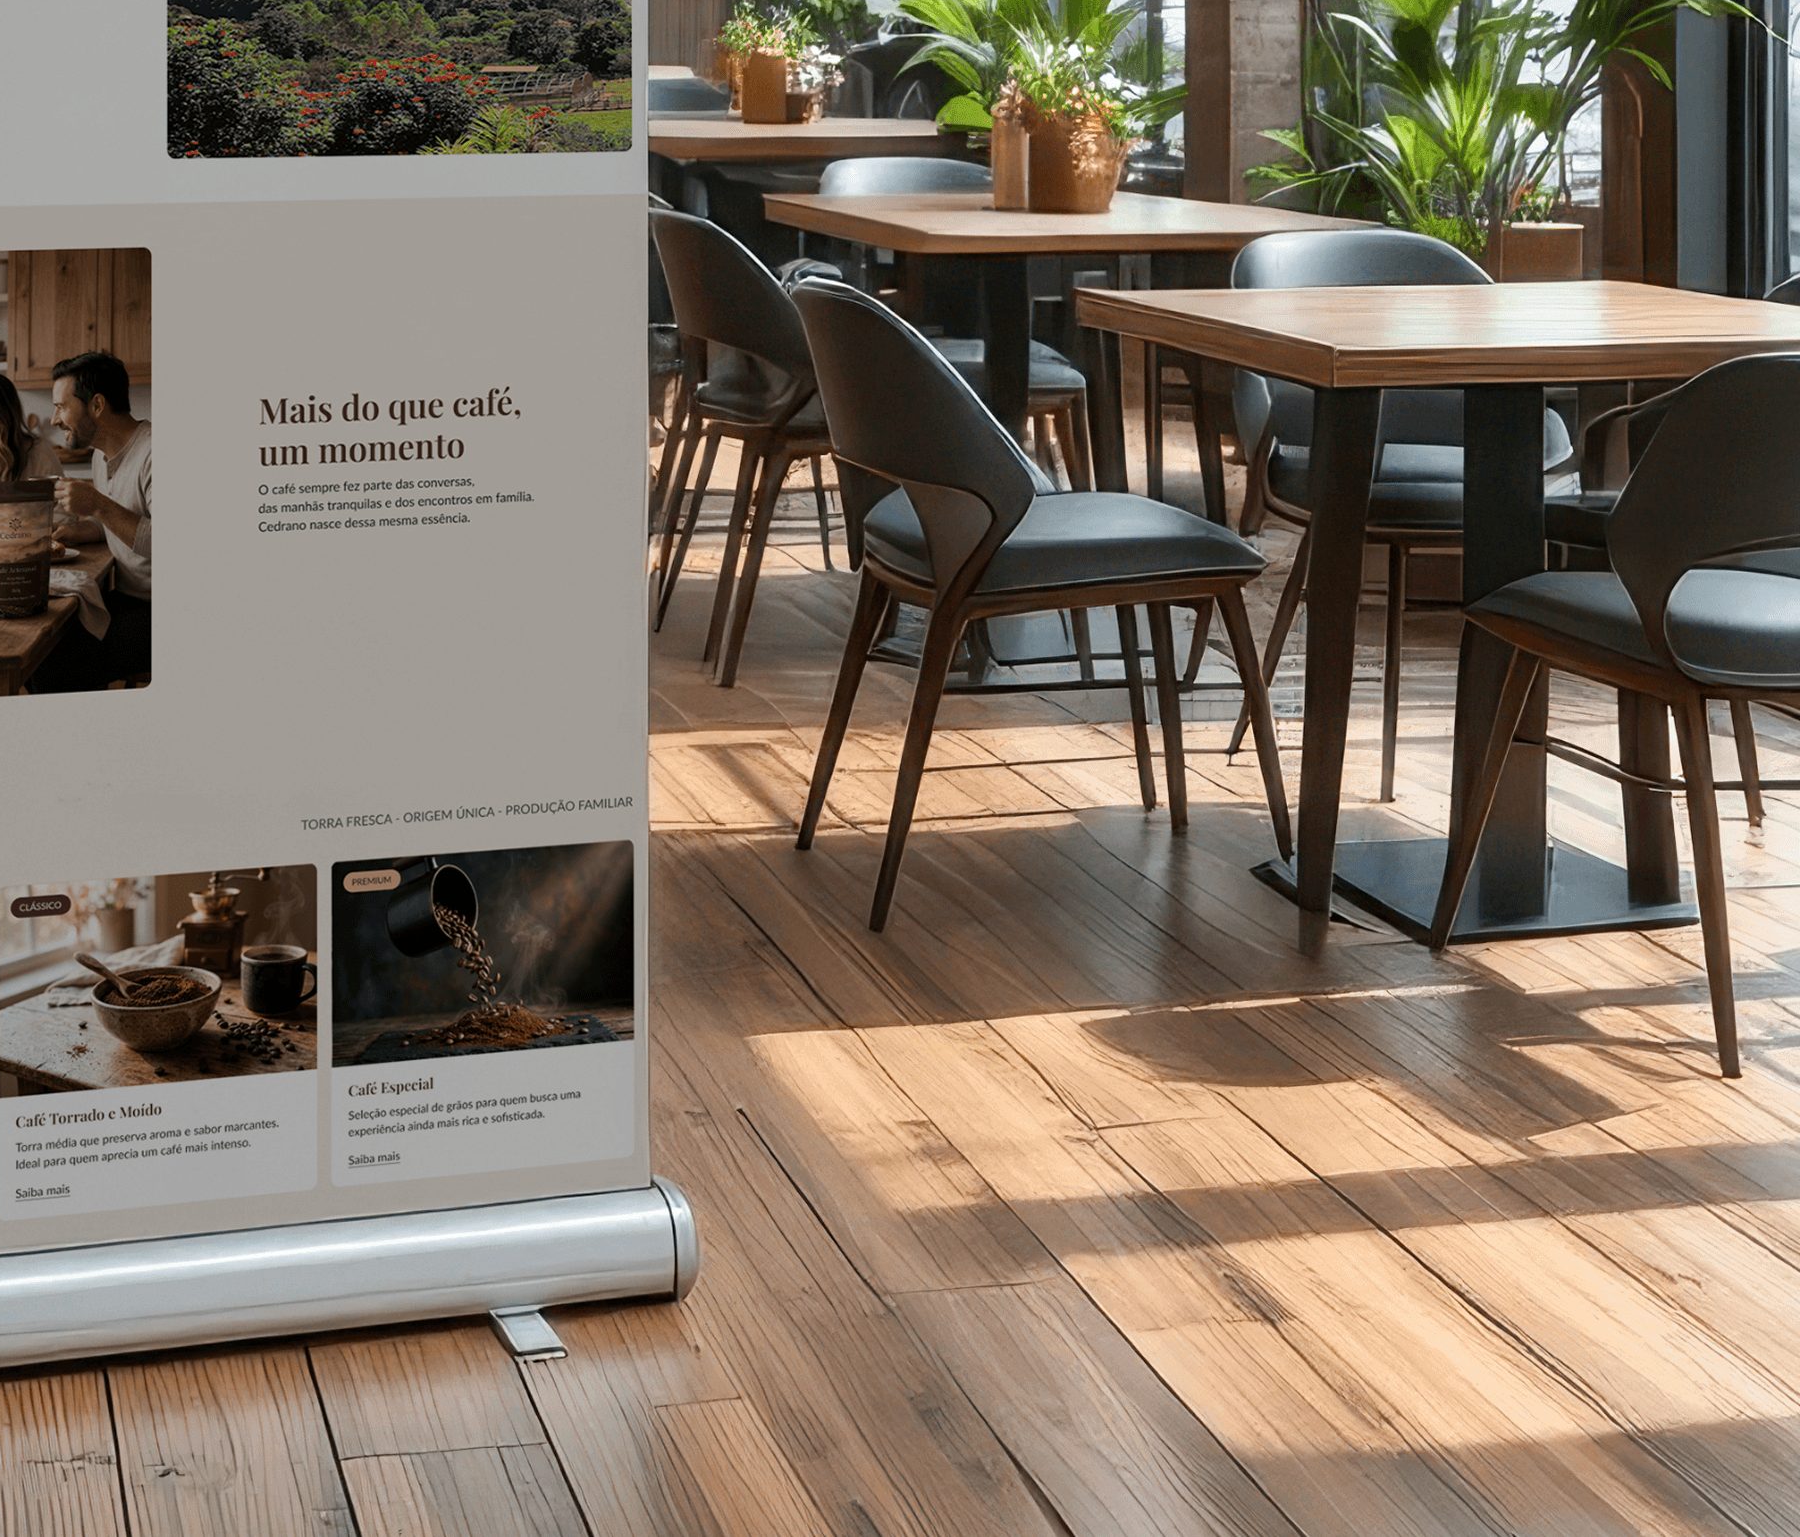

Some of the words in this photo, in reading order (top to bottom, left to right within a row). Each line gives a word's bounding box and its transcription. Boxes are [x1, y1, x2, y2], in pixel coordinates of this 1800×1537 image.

[259, 394, 332, 425] Mais
[341, 392, 379, 422] do
[388, 398, 443, 426] que
[452, 385, 521, 419] café,
[258, 444, 309, 467] um
[318, 434, 464, 464] momento
[258, 484, 269, 496] O
[271, 483, 296, 495] café
[298, 483, 341, 495] sempre
[343, 480, 360, 492] fez
[363, 480, 393, 493] parte
[395, 478, 415, 490] das
[417, 478, 475, 489] conversas,
[300, 817, 344, 830] TORRA
[346, 813, 393, 827] FRESCA
[402, 809, 452, 823] ORIGEM
[456, 805, 495, 819] ÚNICA
[505, 799, 575, 815] PRODUÇÃO
[578, 796, 633, 811] FAMILIAR
[352, 876, 392, 886] PREMIUM
[18, 899, 63, 912] CLÁSSICO
[348, 1081, 377, 1097] Café
[381, 1076, 434, 1095] Especial
[15, 1112, 46, 1128] Café
[48, 1108, 105, 1125] Torrado
[108, 1110, 116, 1120] e
[120, 1103, 162, 1118] Moído
[15, 1142, 42, 1153] Torra
[45, 1137, 77, 1150] média
[79, 1137, 100, 1148] que
[102, 1132, 147, 1146] preserva
[149, 1129, 182, 1140] aroma
[184, 1128, 191, 1137] e
[193, 1124, 222, 1136] sabor
[224, 1120, 279, 1133] marcantes.
[348, 1154, 375, 1166] Saiba
[377, 1150, 401, 1162] mais
[15, 1187, 43, 1199] Saiba
[46, 1184, 70, 1195] mais
